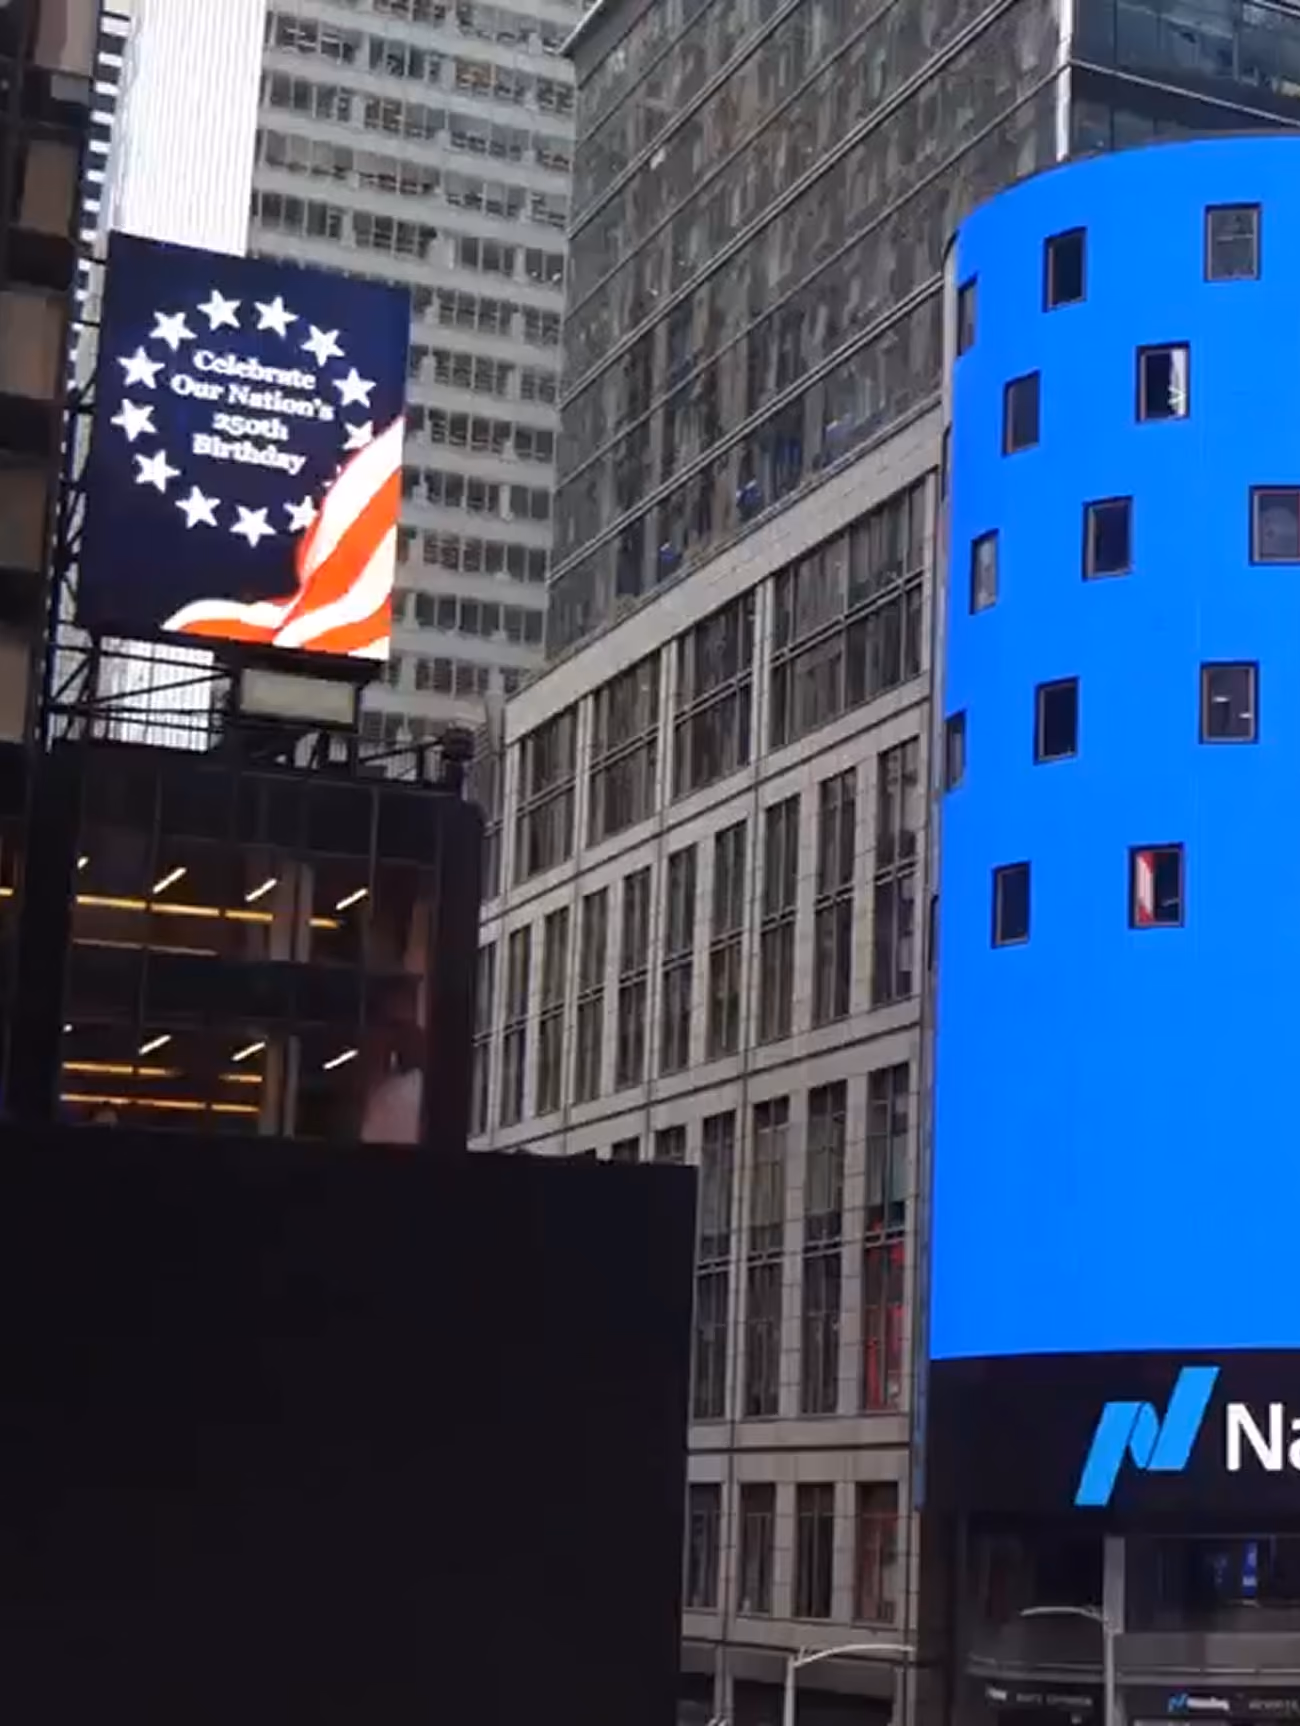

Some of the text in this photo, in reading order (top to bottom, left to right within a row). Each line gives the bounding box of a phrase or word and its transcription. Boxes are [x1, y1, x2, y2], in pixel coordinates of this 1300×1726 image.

[192, 349, 317, 391] Celebrate
[170, 374, 335, 422] Our Nation's
[212, 412, 290, 442] 250th
[193, 434, 308, 475] Birthday
